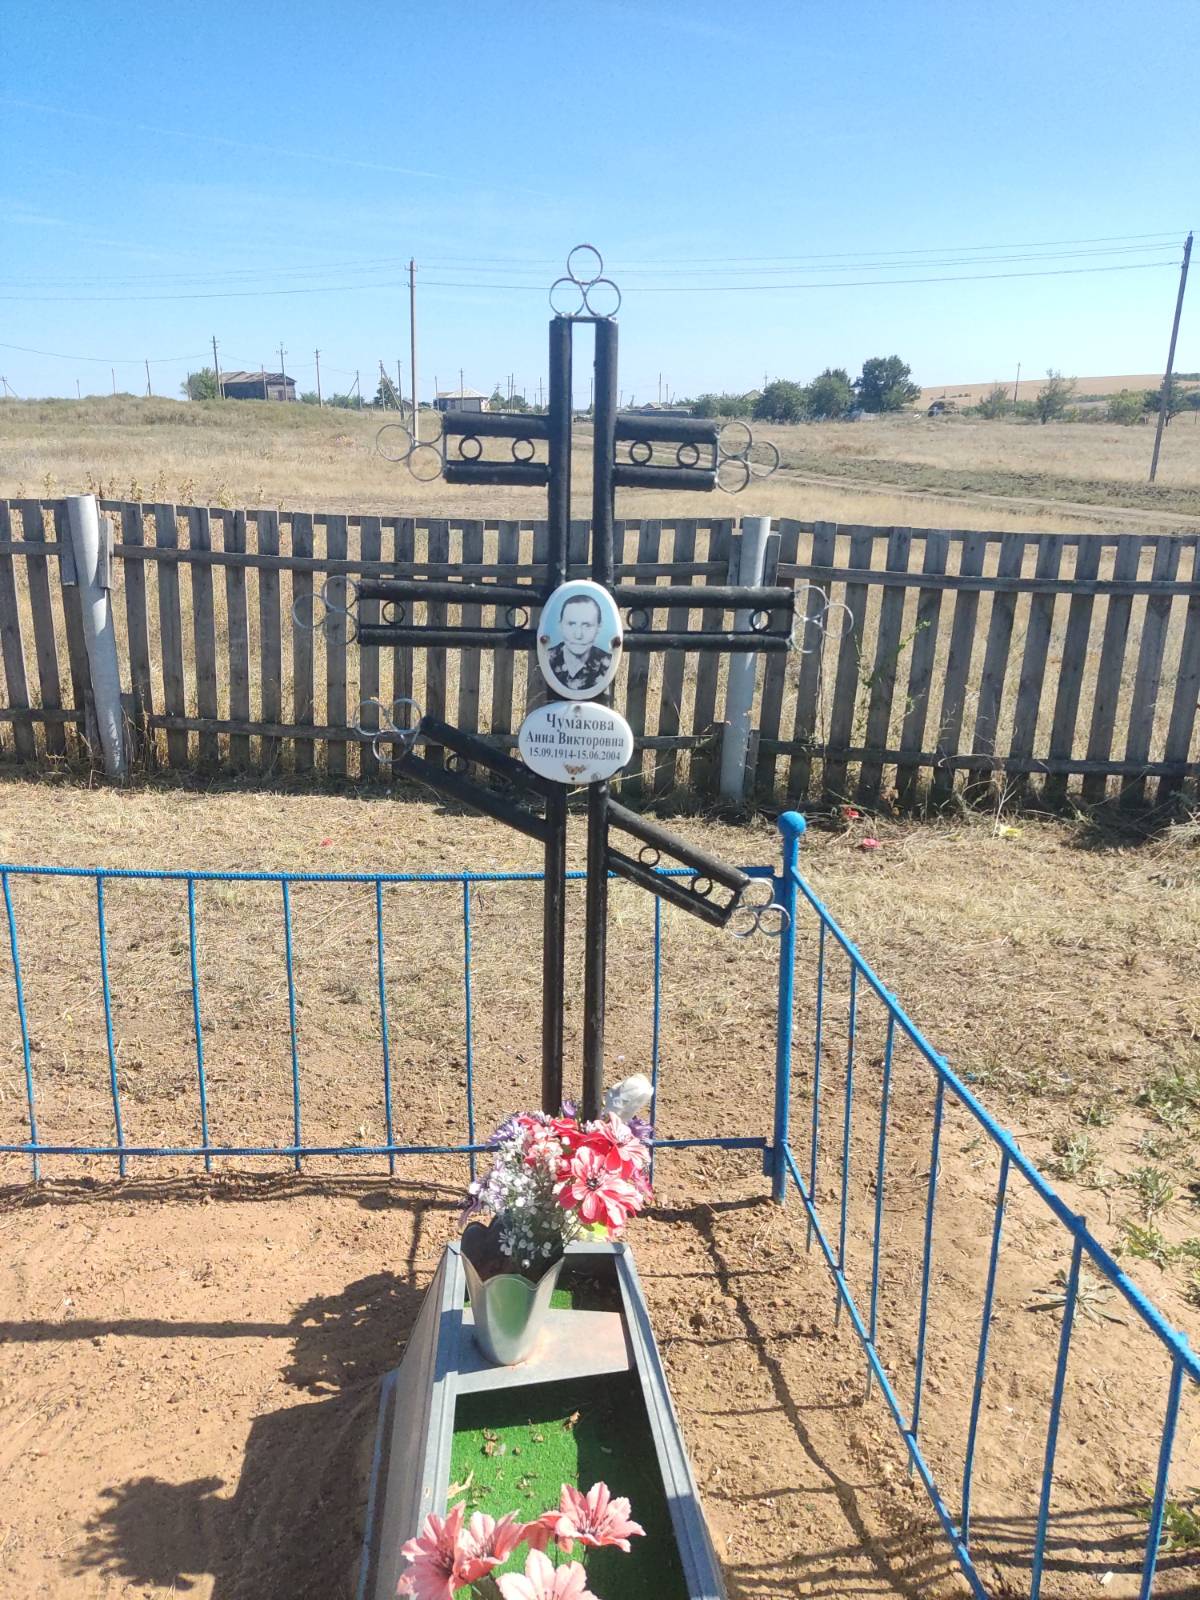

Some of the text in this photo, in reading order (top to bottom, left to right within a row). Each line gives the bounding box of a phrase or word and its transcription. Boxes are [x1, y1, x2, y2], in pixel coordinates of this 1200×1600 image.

[546, 713, 615, 732] Чумакова
[526, 730, 624, 749] Анна Викторовна
